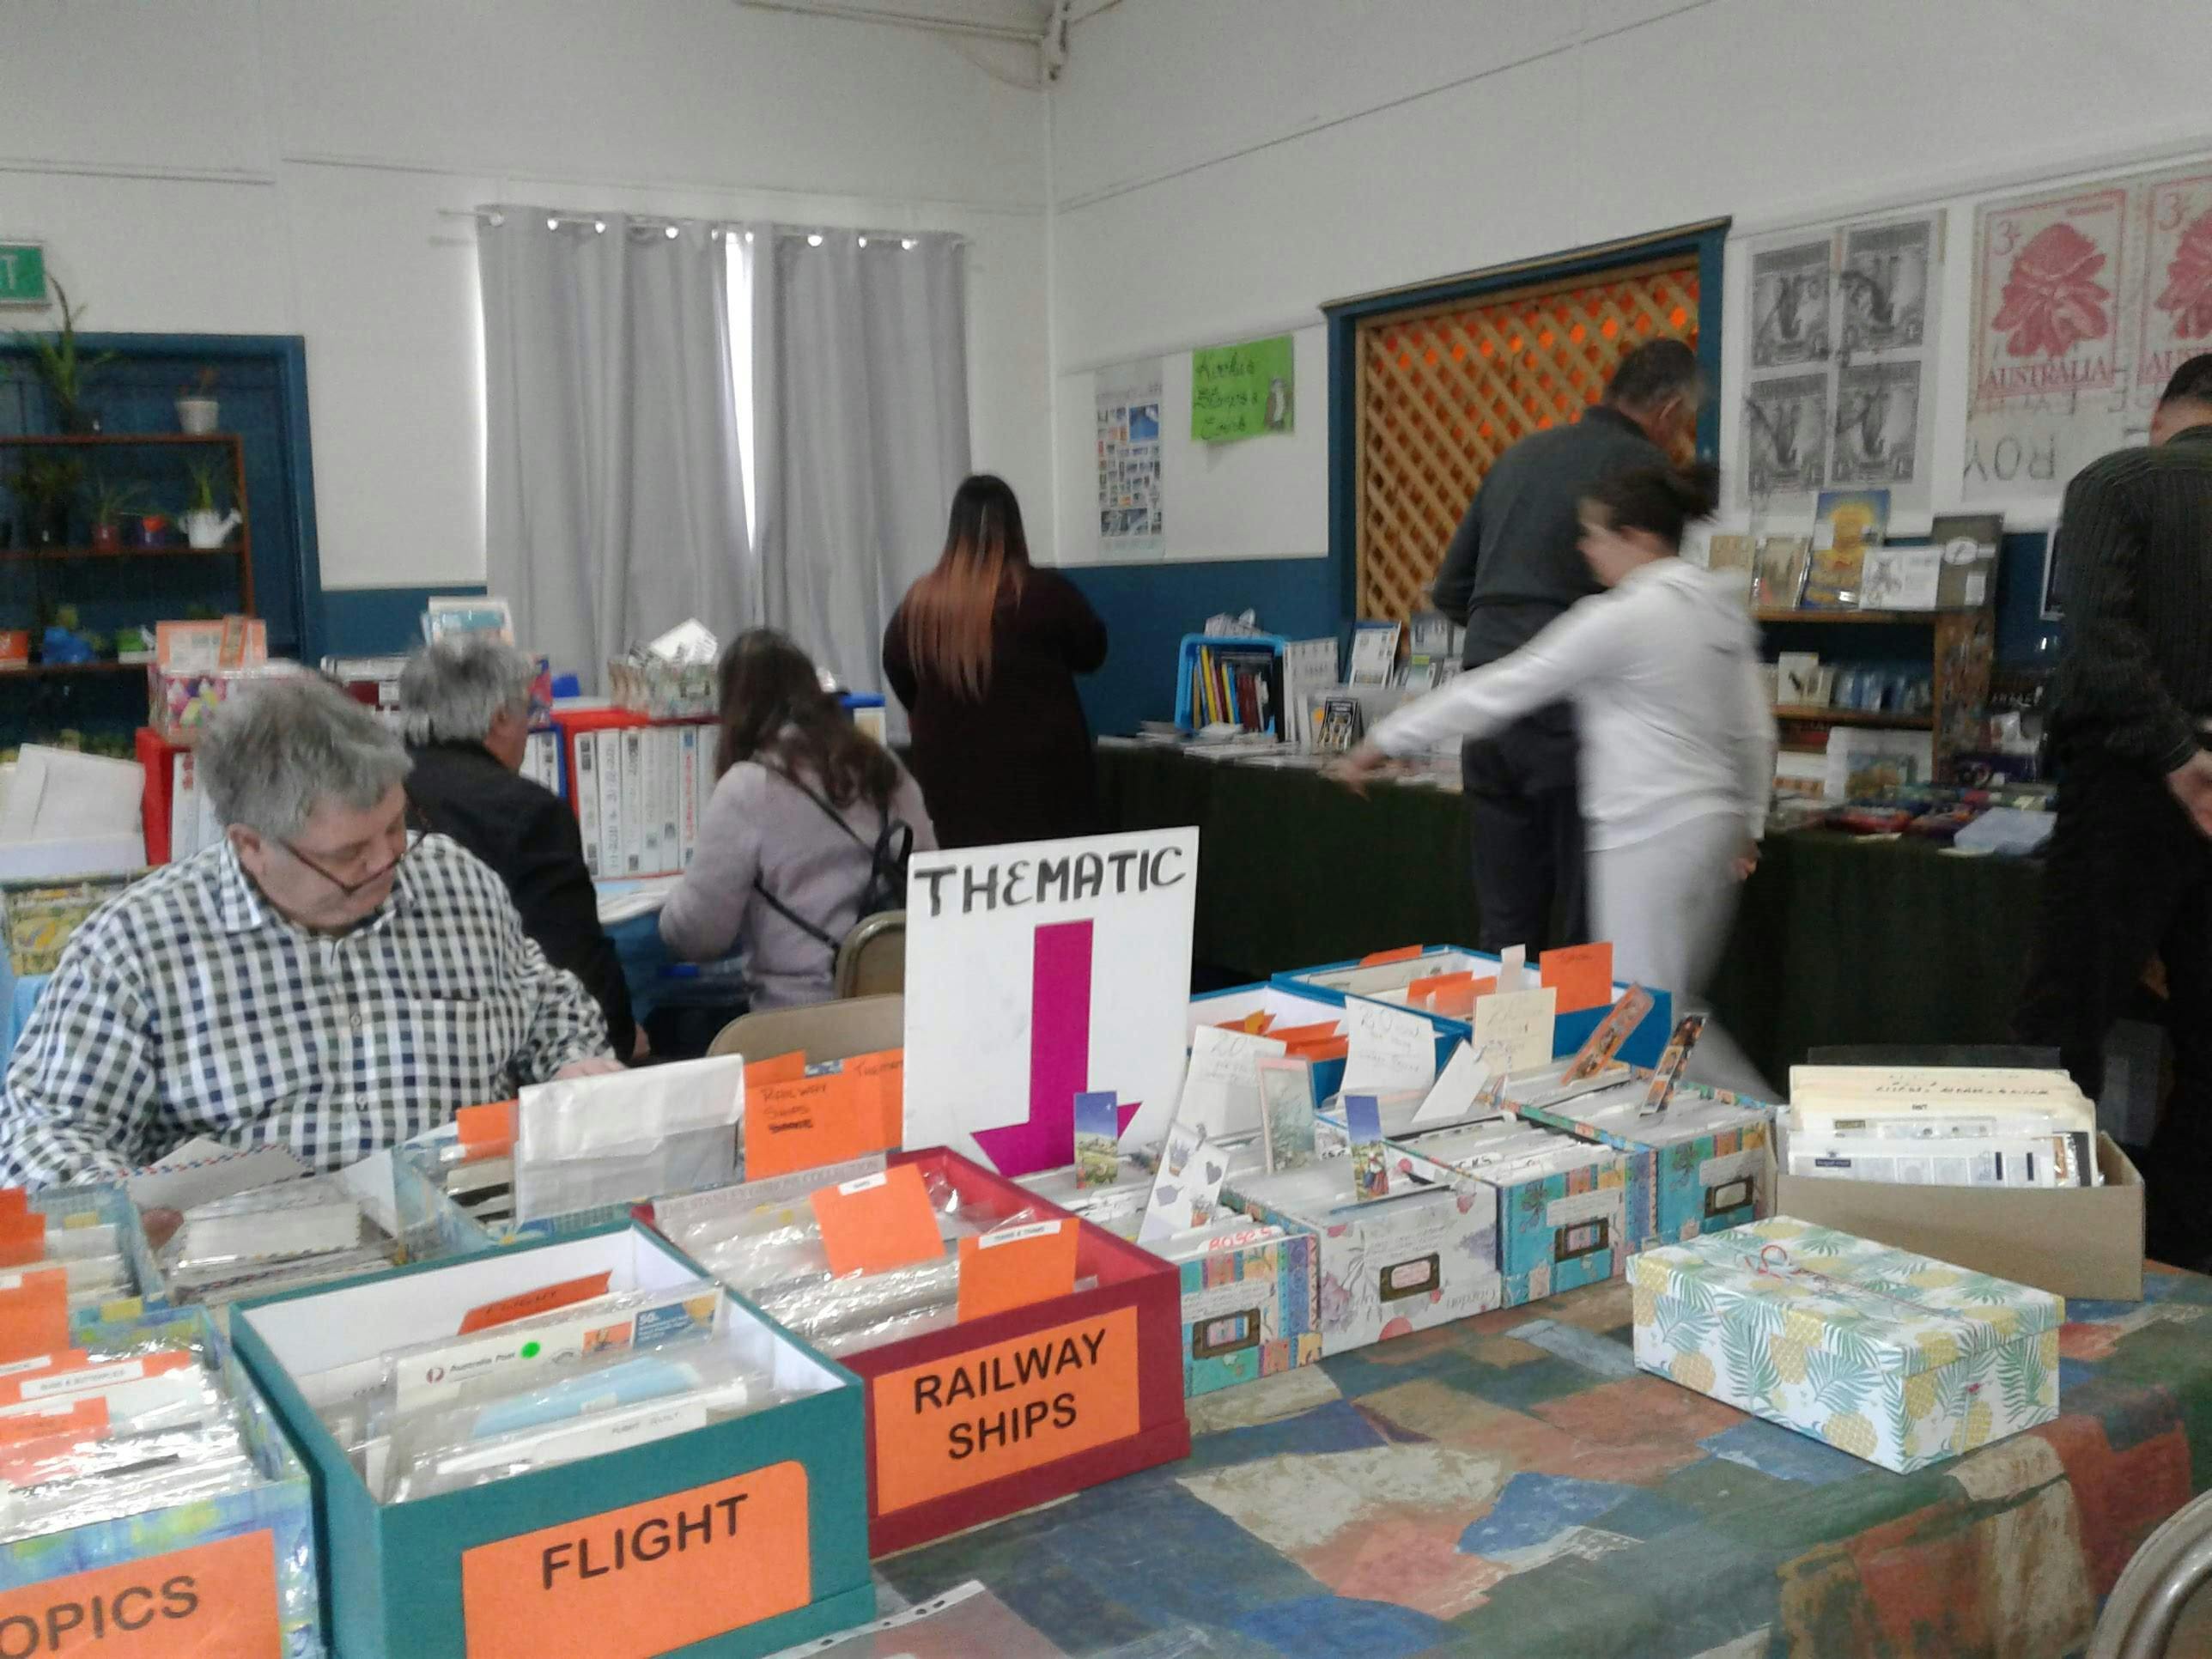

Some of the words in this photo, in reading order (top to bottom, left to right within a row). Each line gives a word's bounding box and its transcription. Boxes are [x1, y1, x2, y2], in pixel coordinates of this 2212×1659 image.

[1984, 354, 2109, 388] AUSTRALIA
[914, 846, 1187, 918] THEMATIC
[449, 1358, 493, 1372] Australia
[914, 1328, 1106, 1415] RAILWAY
[948, 1392, 1078, 1461] SHIPS
[542, 1492, 749, 1590] FLIGHT
